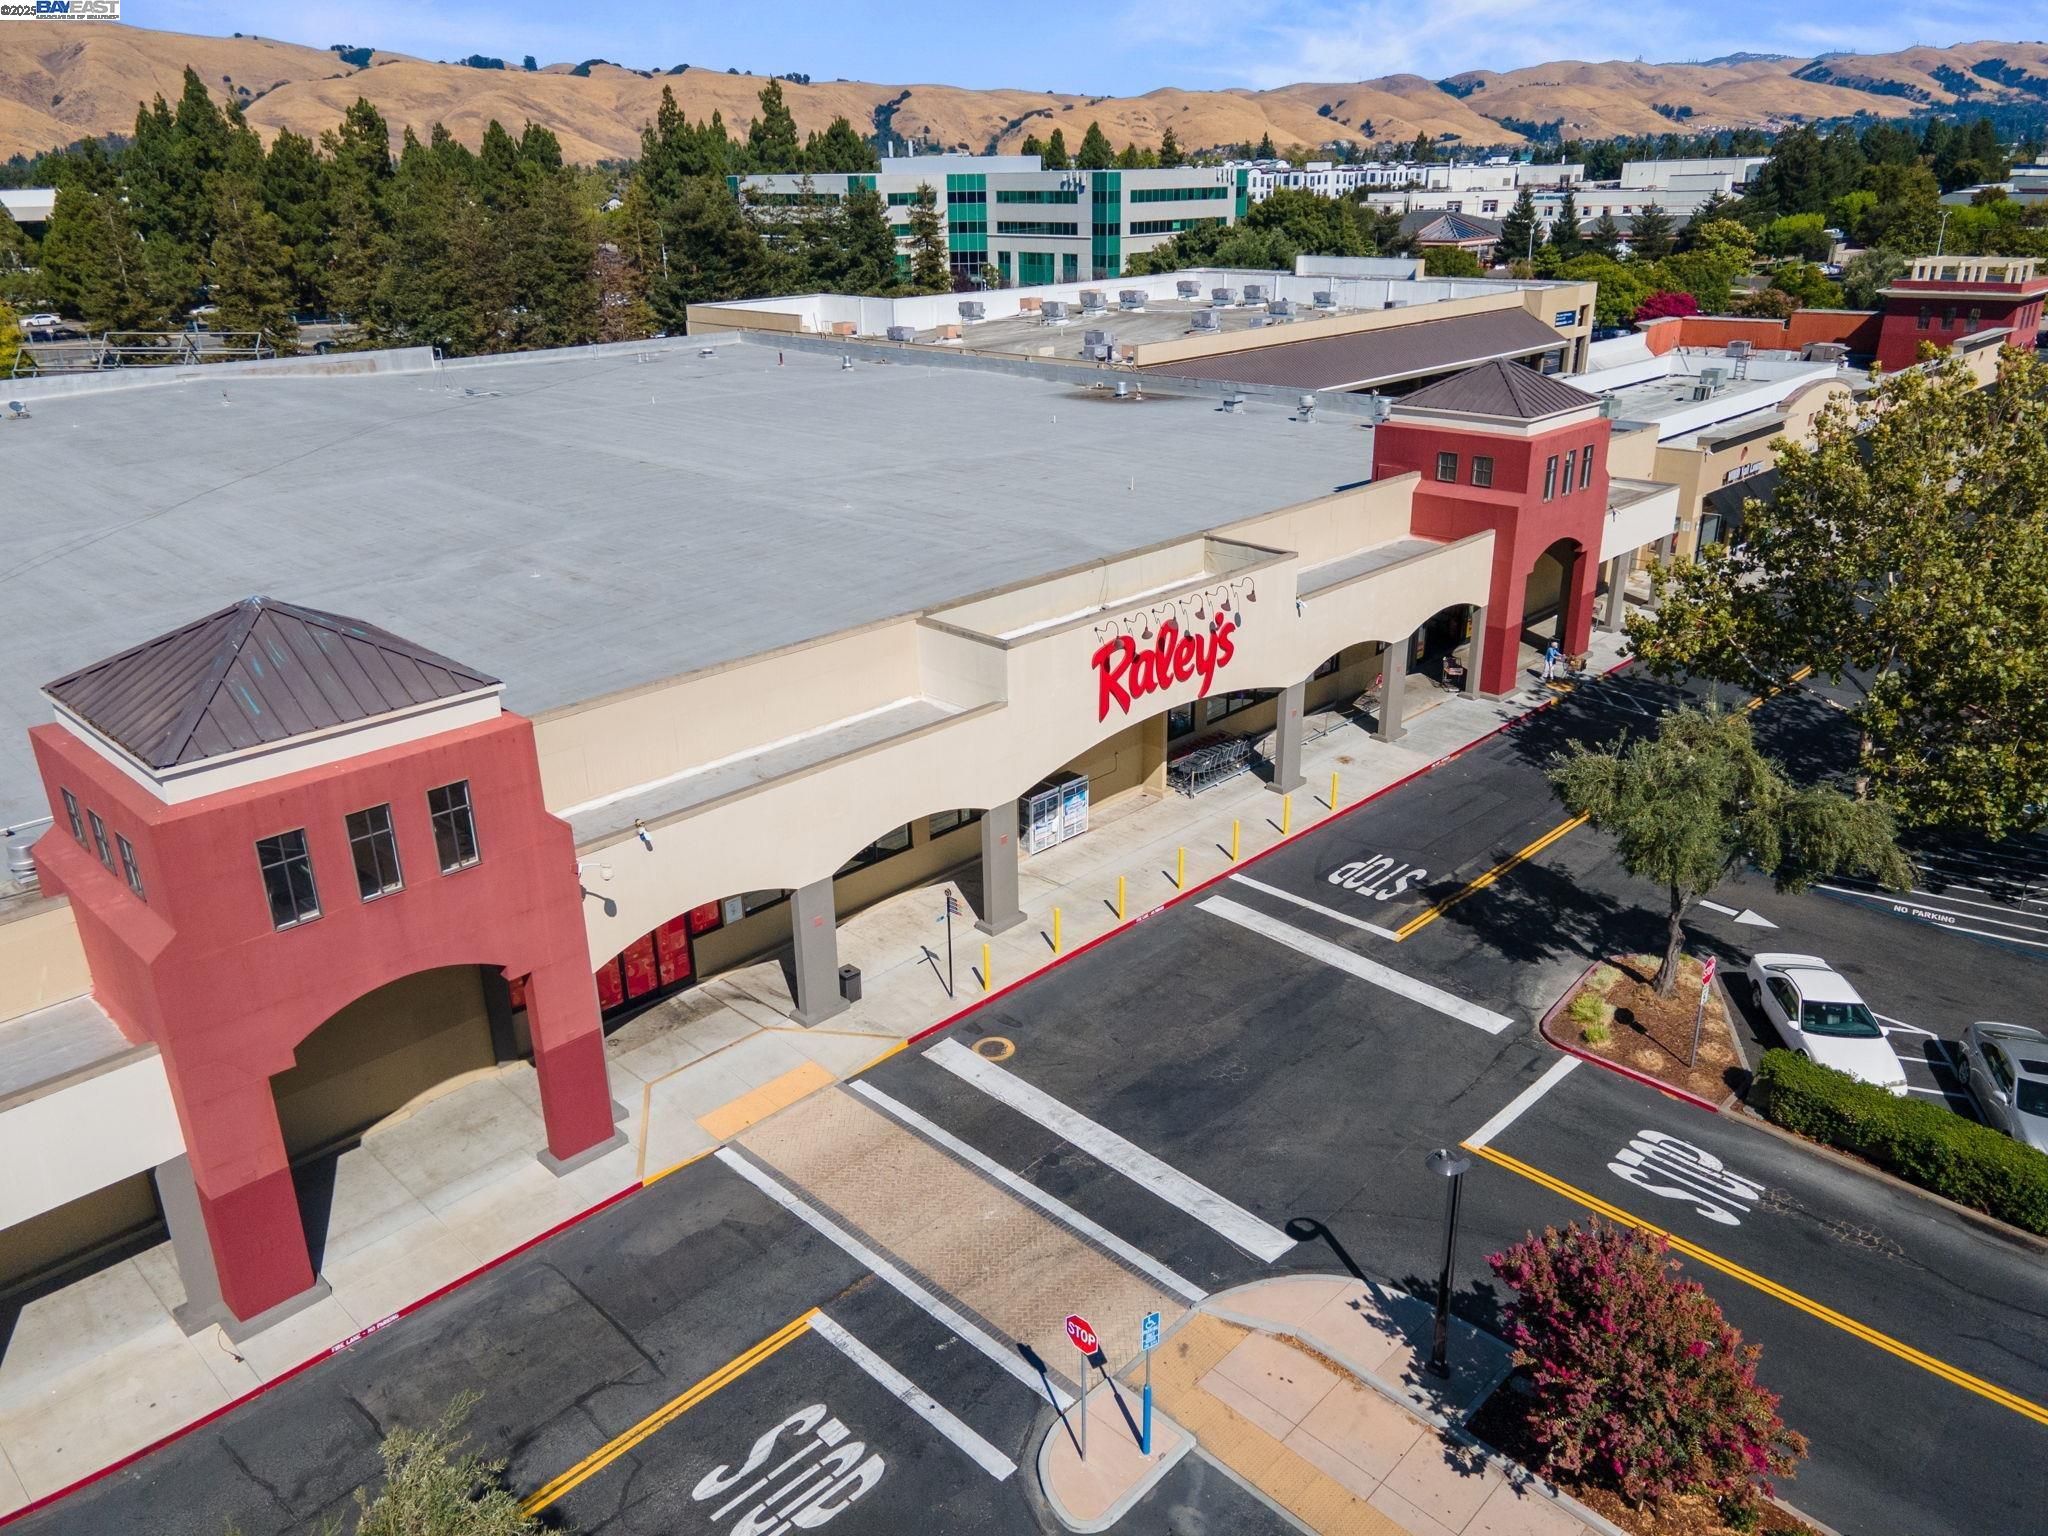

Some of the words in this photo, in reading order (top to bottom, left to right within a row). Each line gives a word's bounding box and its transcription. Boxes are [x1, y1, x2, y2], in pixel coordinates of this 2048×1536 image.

[1091, 611, 1236, 723] Raley's
[1328, 854, 1427, 900] STOP
[1893, 905, 1908, 914] NO
[1912, 909, 1956, 924] PARKING
[1607, 1130, 1766, 1226] STOP
[1068, 1321, 1096, 1345] STOP
[692, 1403, 885, 1536] STOP
